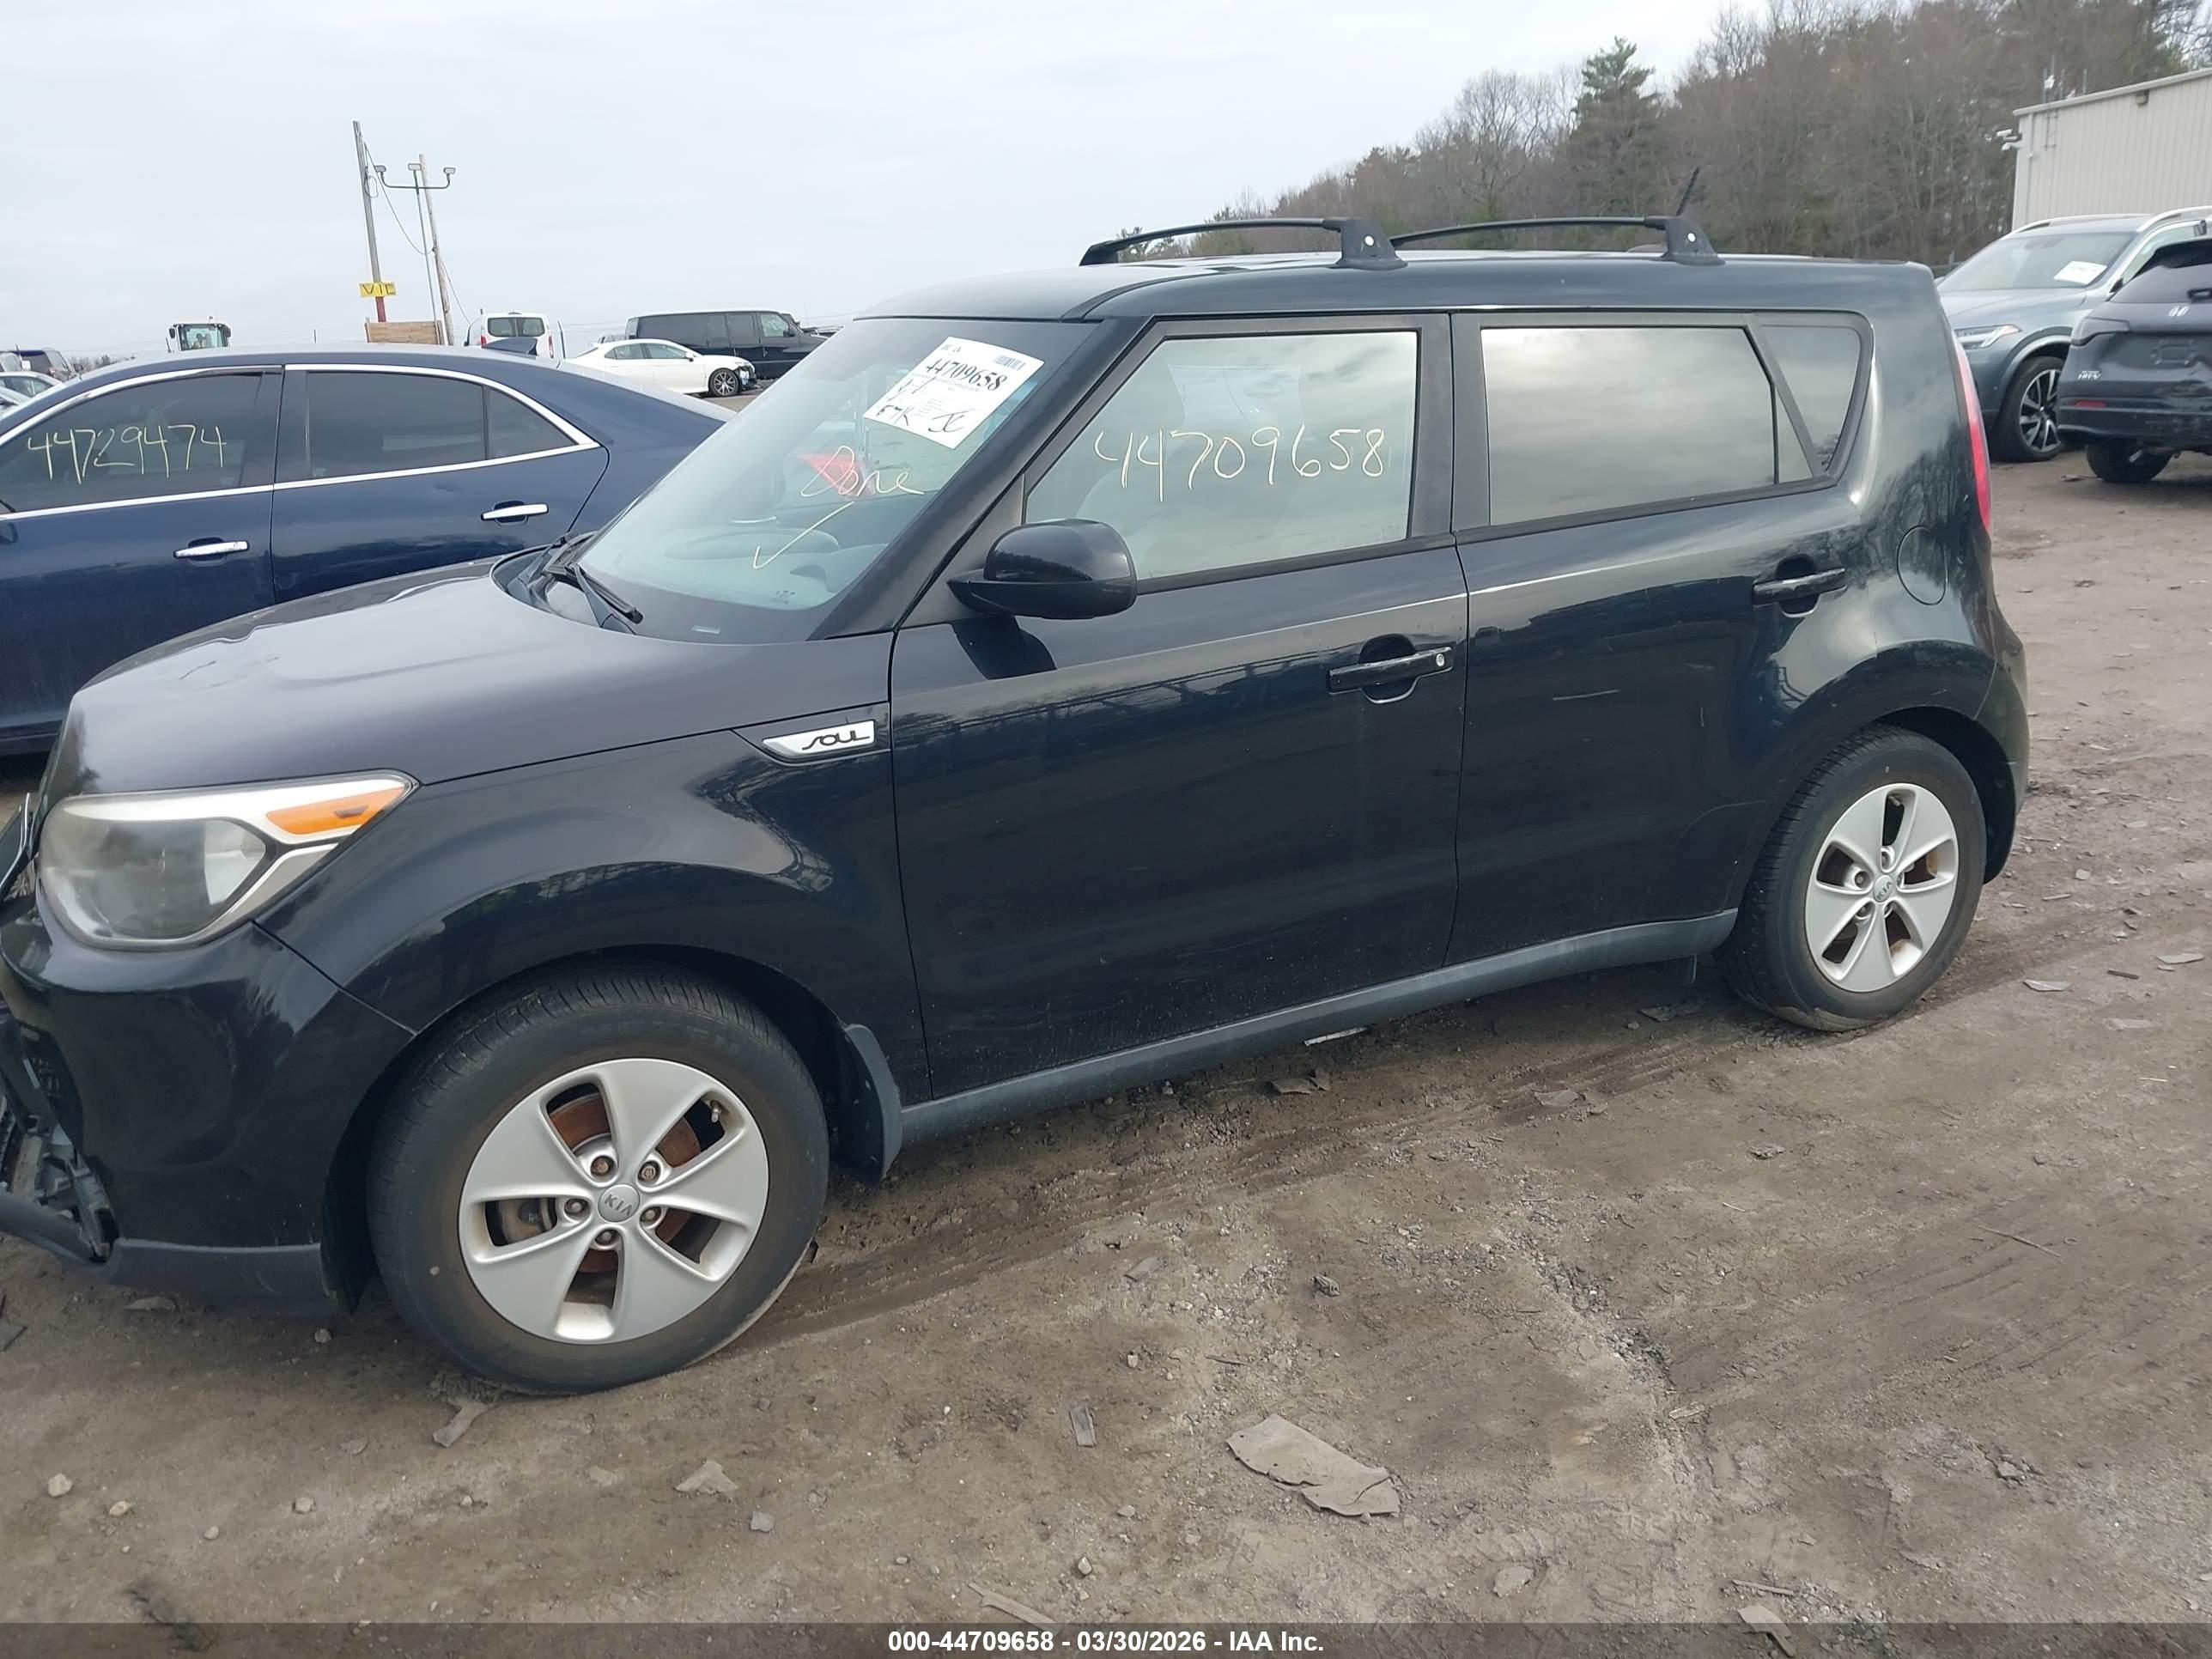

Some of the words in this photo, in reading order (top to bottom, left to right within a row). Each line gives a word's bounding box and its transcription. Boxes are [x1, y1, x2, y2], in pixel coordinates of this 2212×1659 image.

[926, 358, 1007, 392] 44709658
[27, 424, 228, 485] 44729474
[1093, 423, 1386, 503] 44709658
[801, 729, 871, 750] SOUL
[1875, 881, 1893, 901] KIA
[604, 1193, 633, 1217] KIA
